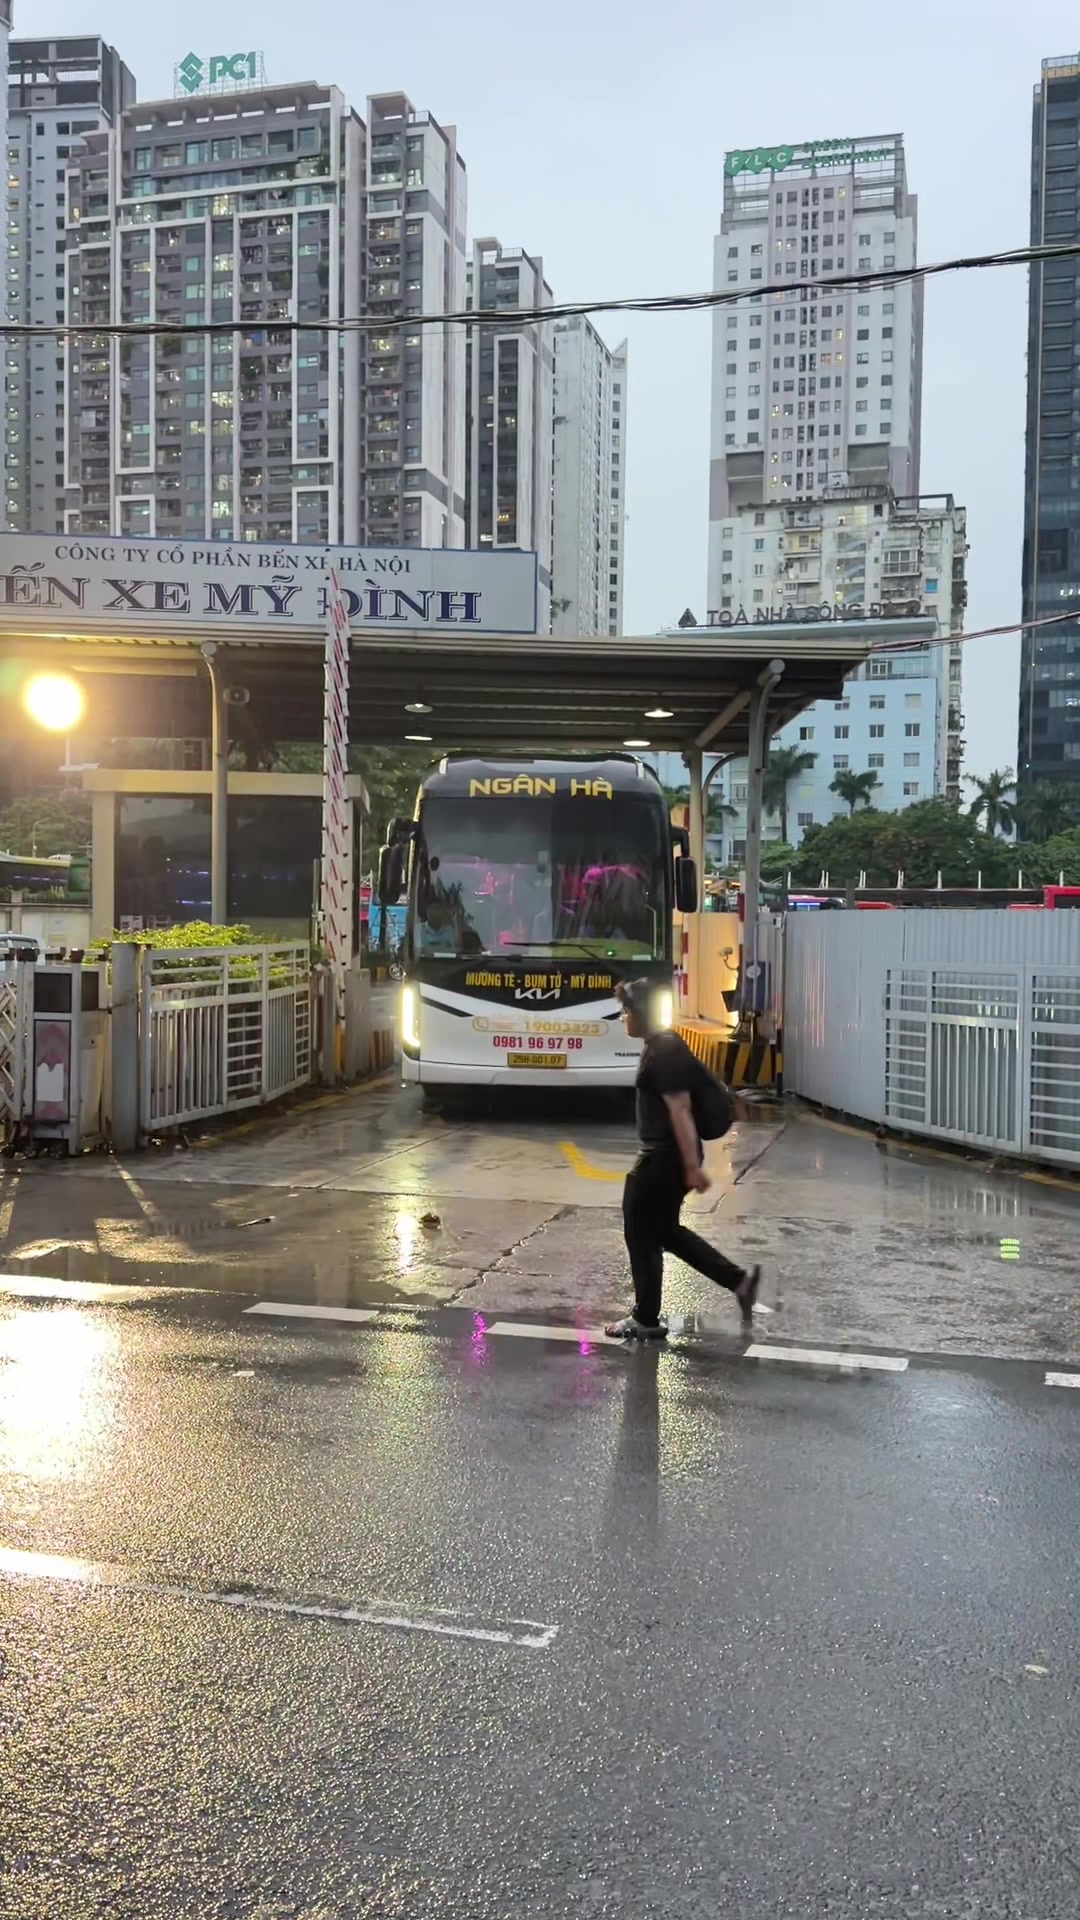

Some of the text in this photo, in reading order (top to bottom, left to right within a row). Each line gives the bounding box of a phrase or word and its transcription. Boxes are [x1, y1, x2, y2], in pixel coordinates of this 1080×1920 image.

[209, 51, 256, 84] PC1
[54, 542, 116, 562] CÔNG
[122, 547, 150, 563] TY
[157, 543, 184, 565] CỔ
[192, 546, 251, 569] PHẦN
[257, 548, 298, 569] BẾN
[339, 552, 370, 573] HÀ
[374, 555, 411, 576] NỘI
[102, 578, 192, 613] XE
[203, 574, 302, 616] MỸ
[707, 604, 749, 627] TOÀ
[755, 602, 795, 623] NHÀ
[469, 773, 613, 800] NGÂN HÀ
[525, 973, 547, 988] BUM
[515, 988, 561, 1000] KIA
[493, 1035, 583, 1050] 0981 96 97 98
